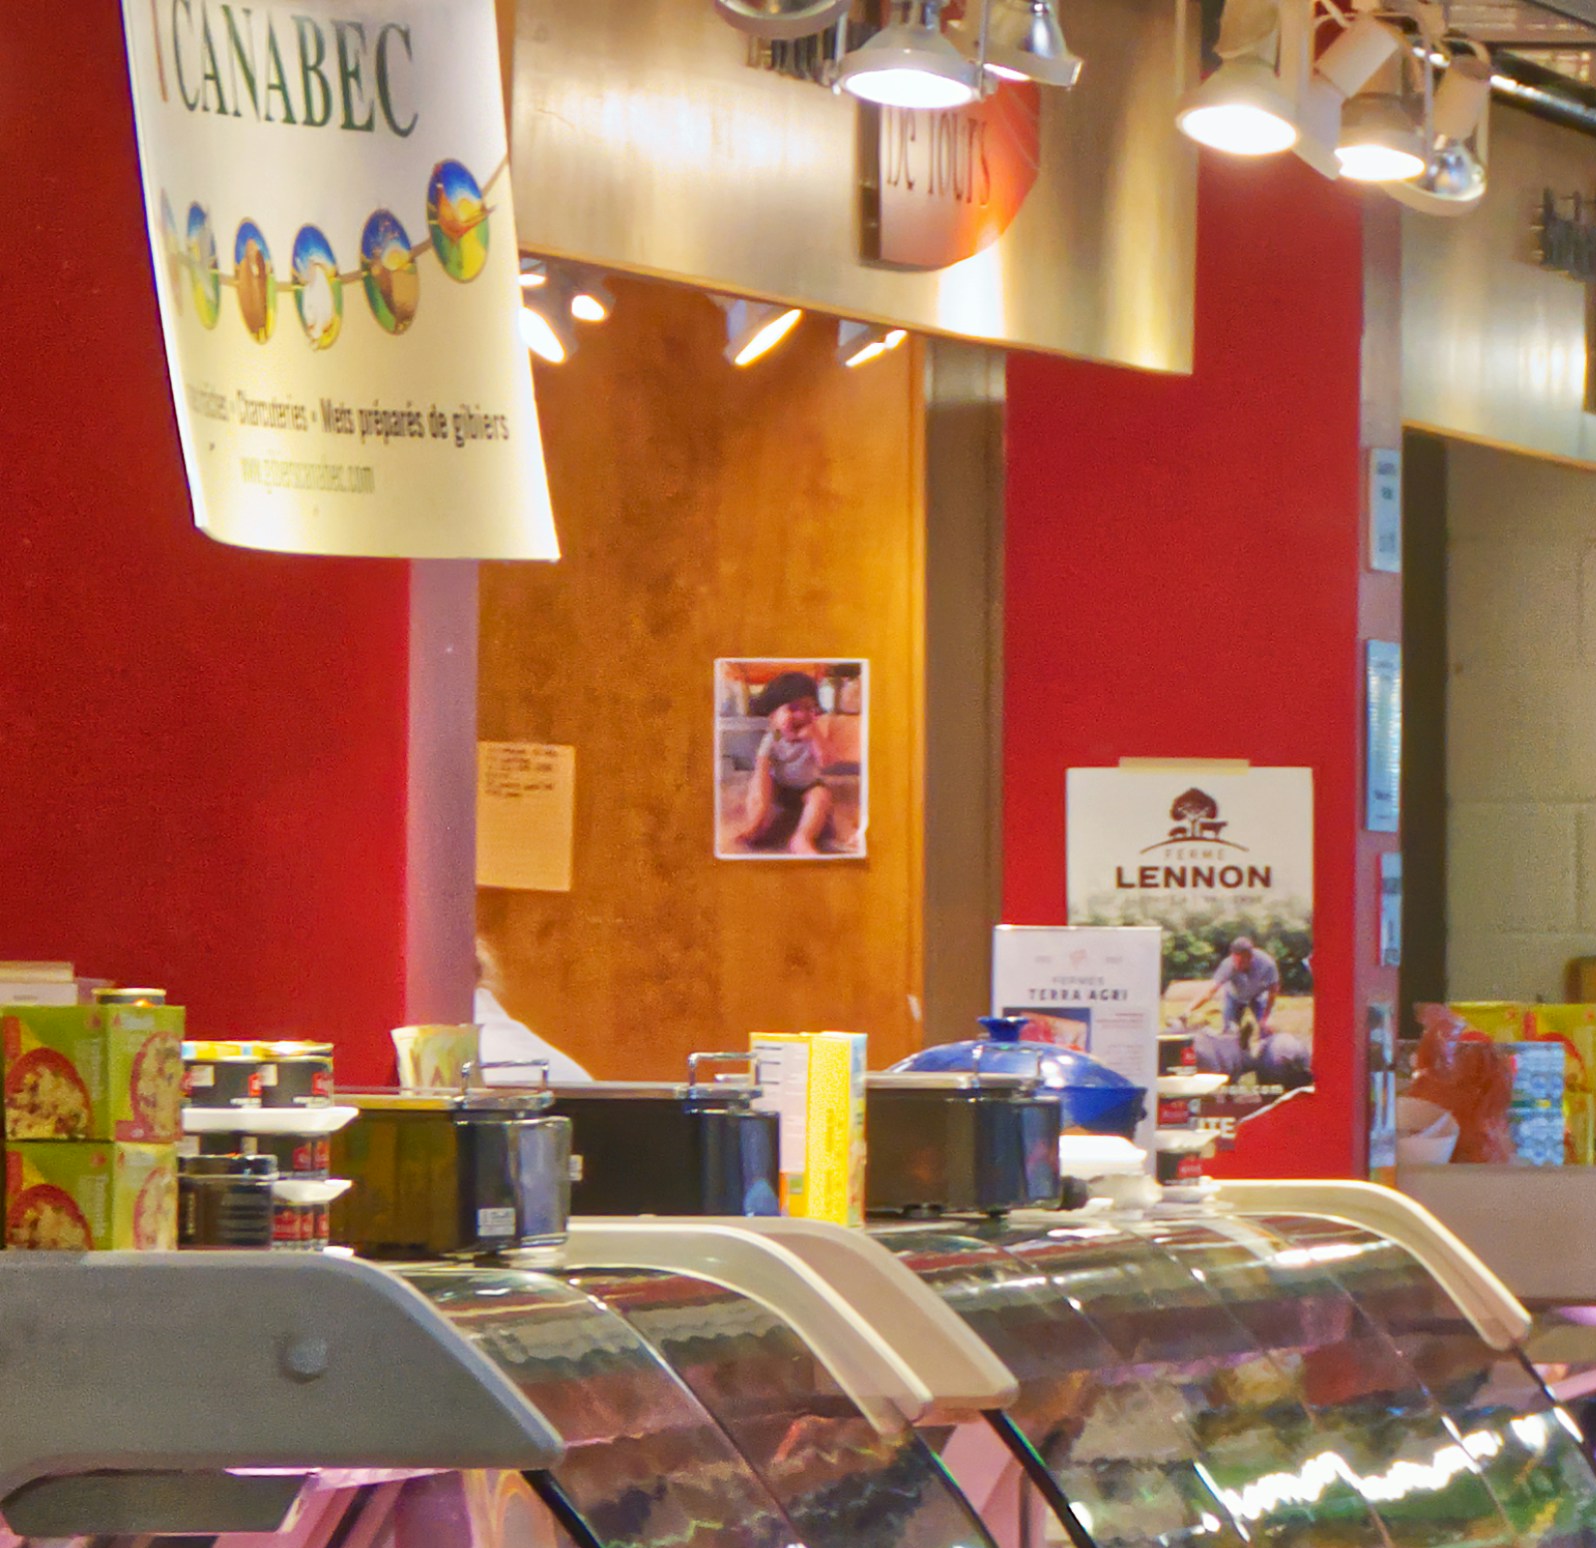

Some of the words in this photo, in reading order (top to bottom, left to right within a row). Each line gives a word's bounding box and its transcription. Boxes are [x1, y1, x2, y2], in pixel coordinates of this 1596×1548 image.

[171, 0, 419, 138] CANABEC
[318, 397, 355, 435] Mets
[428, 403, 449, 440] de
[452, 403, 511, 448] gibiers
[1115, 865, 1272, 889] LENNON
[1028, 988, 1081, 1001] TERRA
